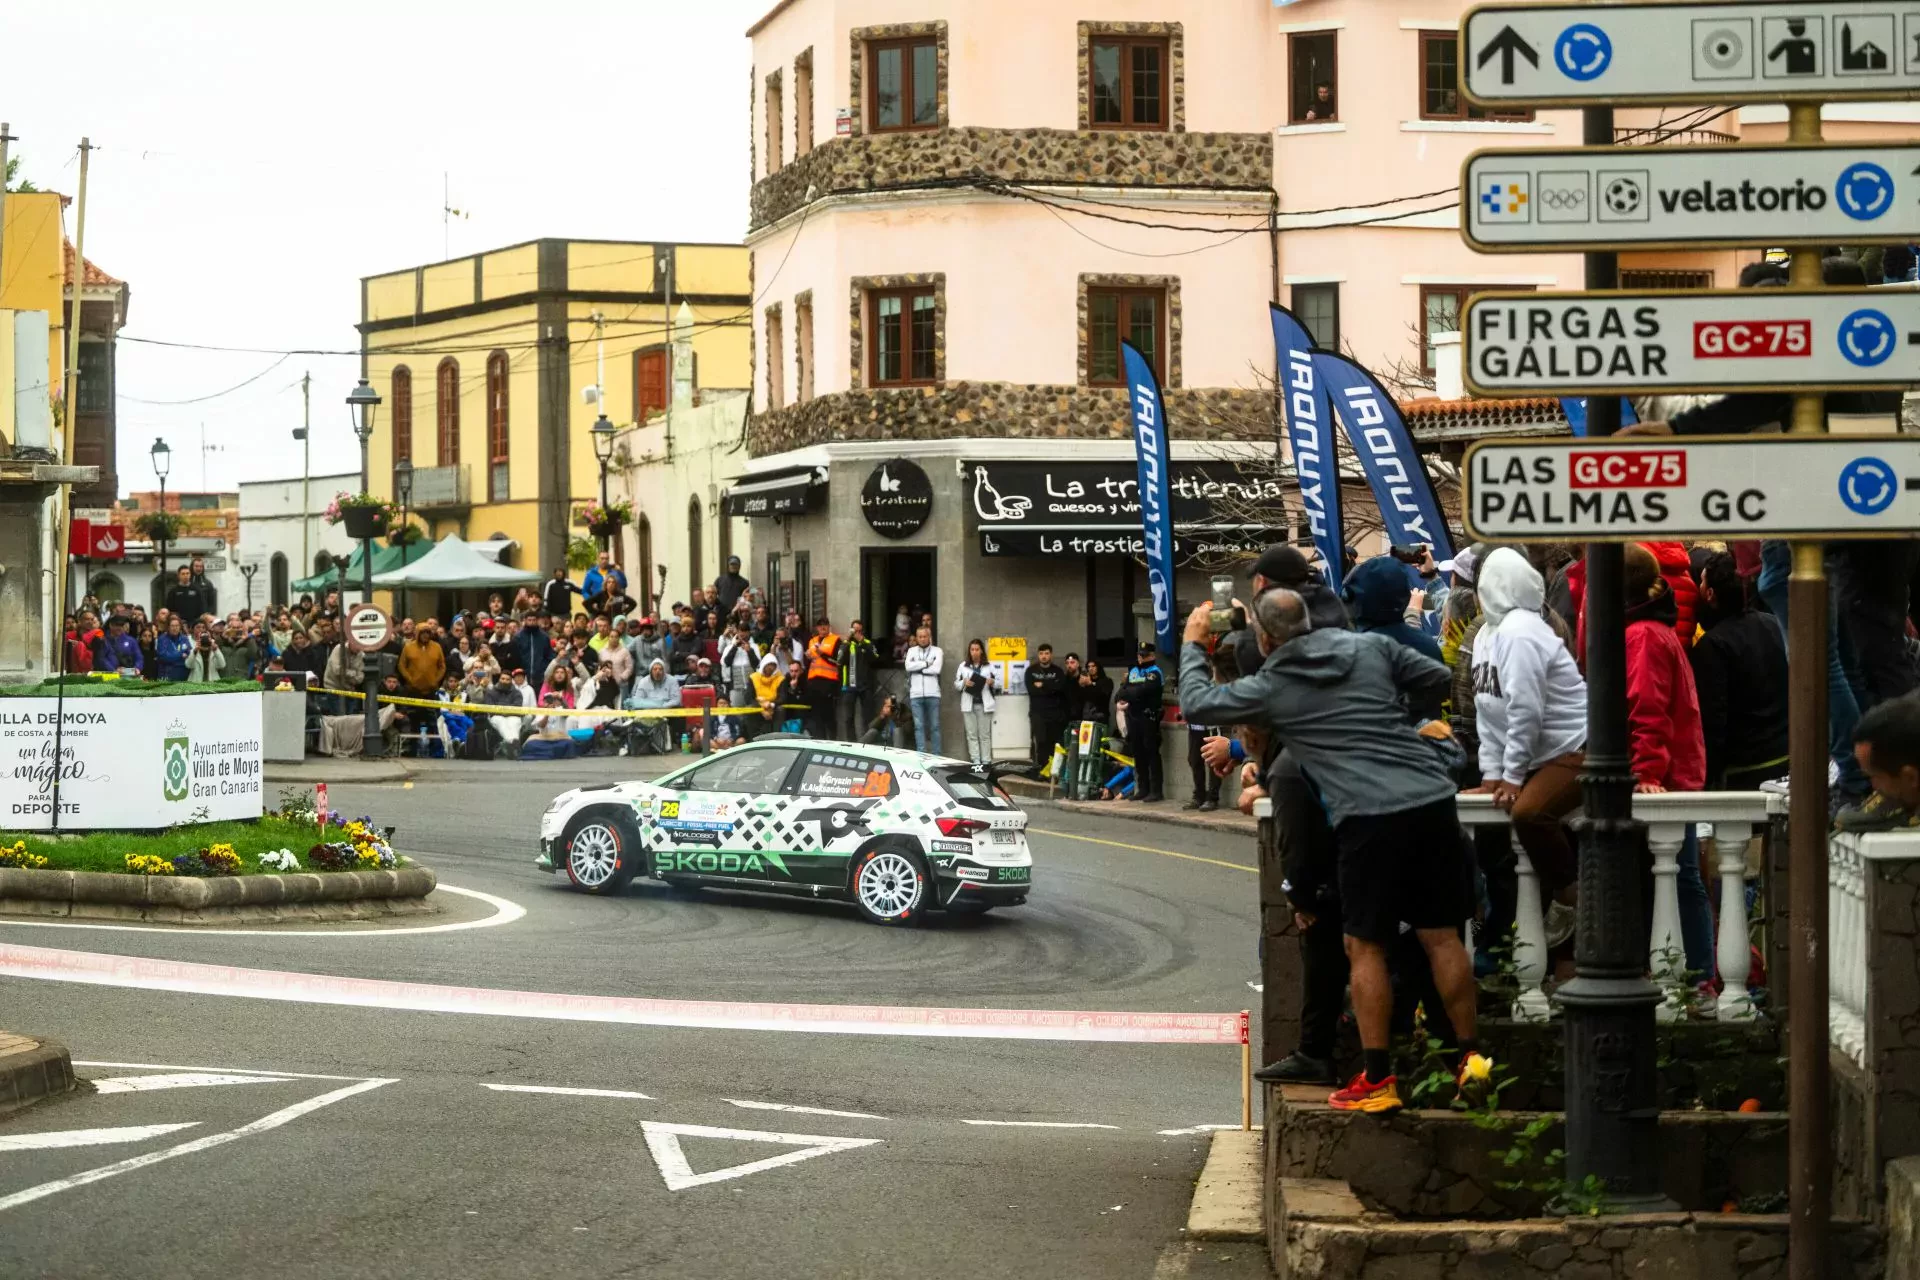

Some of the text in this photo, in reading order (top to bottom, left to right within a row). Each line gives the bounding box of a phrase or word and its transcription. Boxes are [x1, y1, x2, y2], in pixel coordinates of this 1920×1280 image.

[1659, 178, 1827, 213] velatorio
[1479, 307, 1660, 340] FIRGAS
[1699, 325, 1806, 354] GC-75
[1479, 341, 1668, 377] GÁLDAR
[1480, 454, 1682, 485] LAS GC-75
[1045, 474, 1281, 500] La trtienda
[1110, 504, 1117, 515] y
[1121, 500, 1143, 513] vin
[1480, 488, 1767, 524] PALMAS GC
[1040, 535, 1063, 553] La
[37, 713, 58, 724] DE
[63, 713, 107, 724] MOYA
[19, 748, 36, 759] un
[193, 738, 259, 759] Ayuntamiento
[193, 757, 259, 778] Villa de Moya
[900, 770, 923, 780] NG
[193, 778, 259, 797] Gran Canaria
[863, 771, 892, 796] 28
[660, 801, 679, 817] 28
